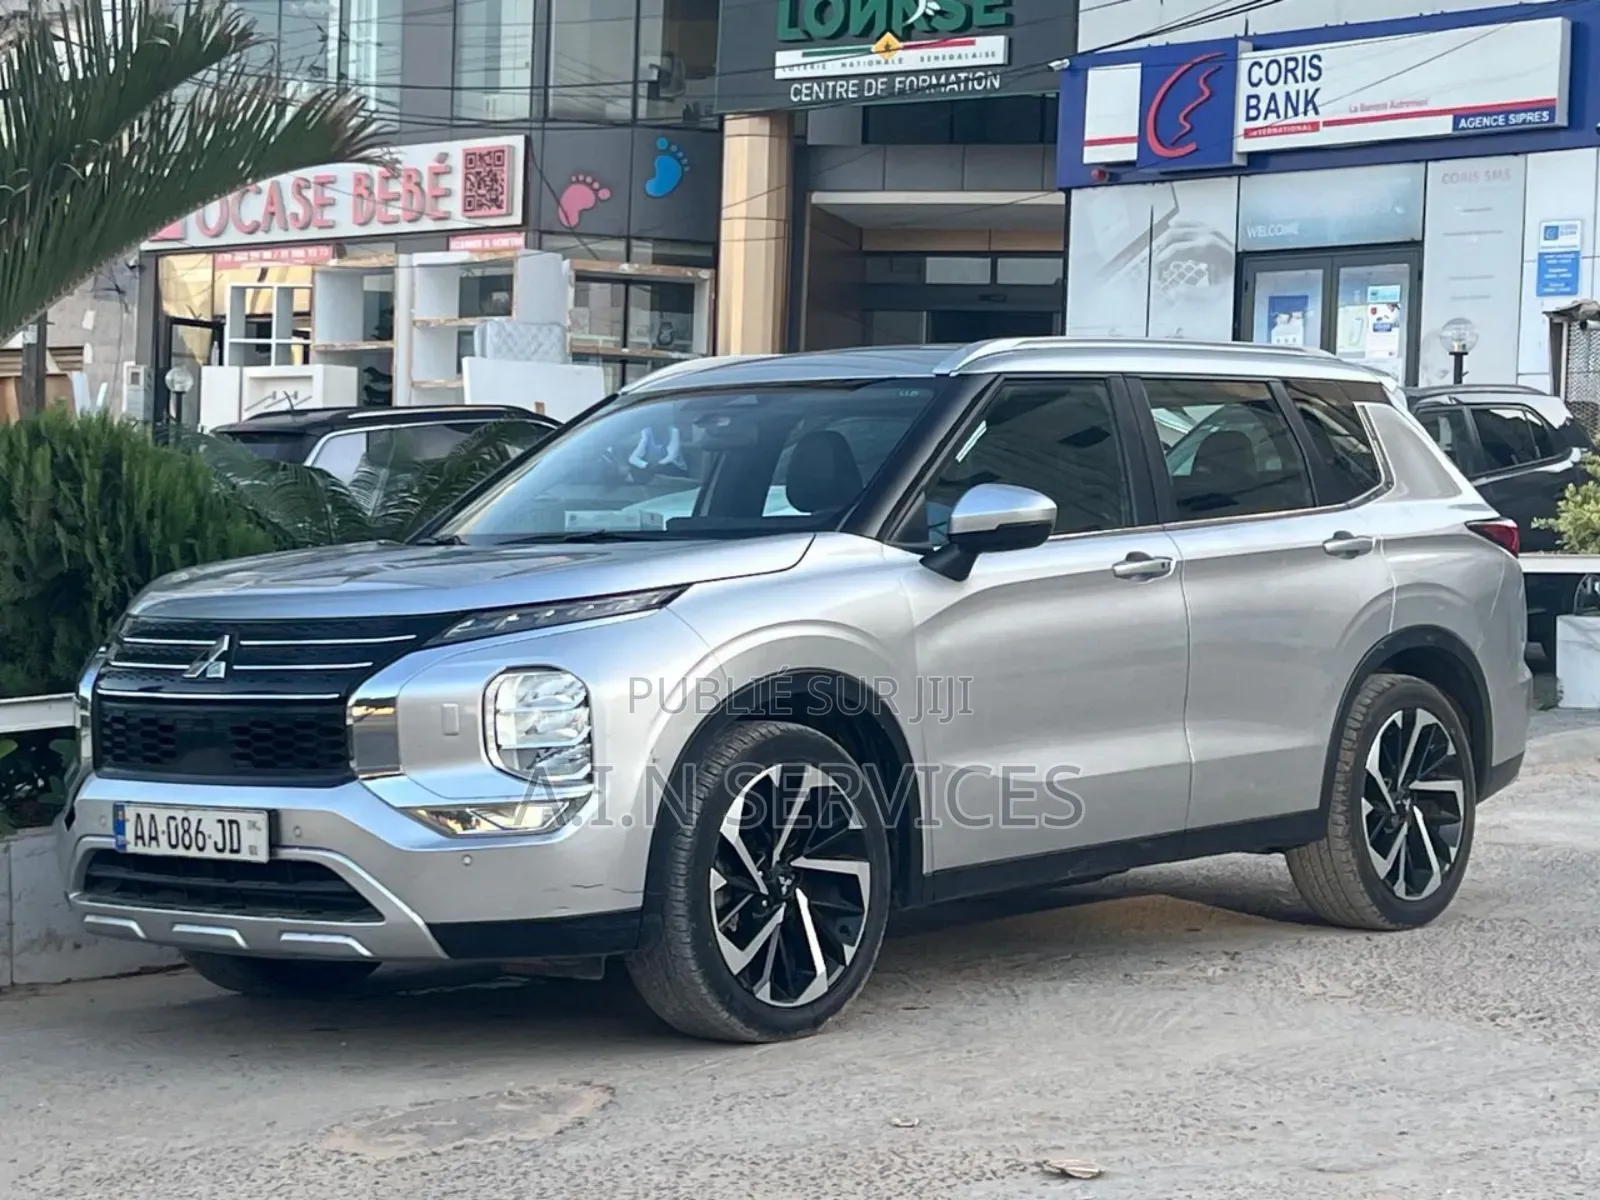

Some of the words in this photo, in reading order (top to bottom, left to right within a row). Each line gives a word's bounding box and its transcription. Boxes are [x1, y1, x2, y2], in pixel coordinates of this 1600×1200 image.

[840, 57, 903, 68] NATIONALE
[1247, 54, 1323, 88] CORIS
[790, 80, 859, 102] CENTRE
[864, 78, 888, 96] DE
[894, 71, 1001, 95] FORMATION
[1245, 88, 1321, 122] BANK
[1459, 114, 1505, 129] AGENCE
[1508, 110, 1550, 124] SIPRES
[1441, 171, 1480, 185] CORIS
[1484, 168, 1511, 183] SMS
[1245, 221, 1300, 239] WELCOME
